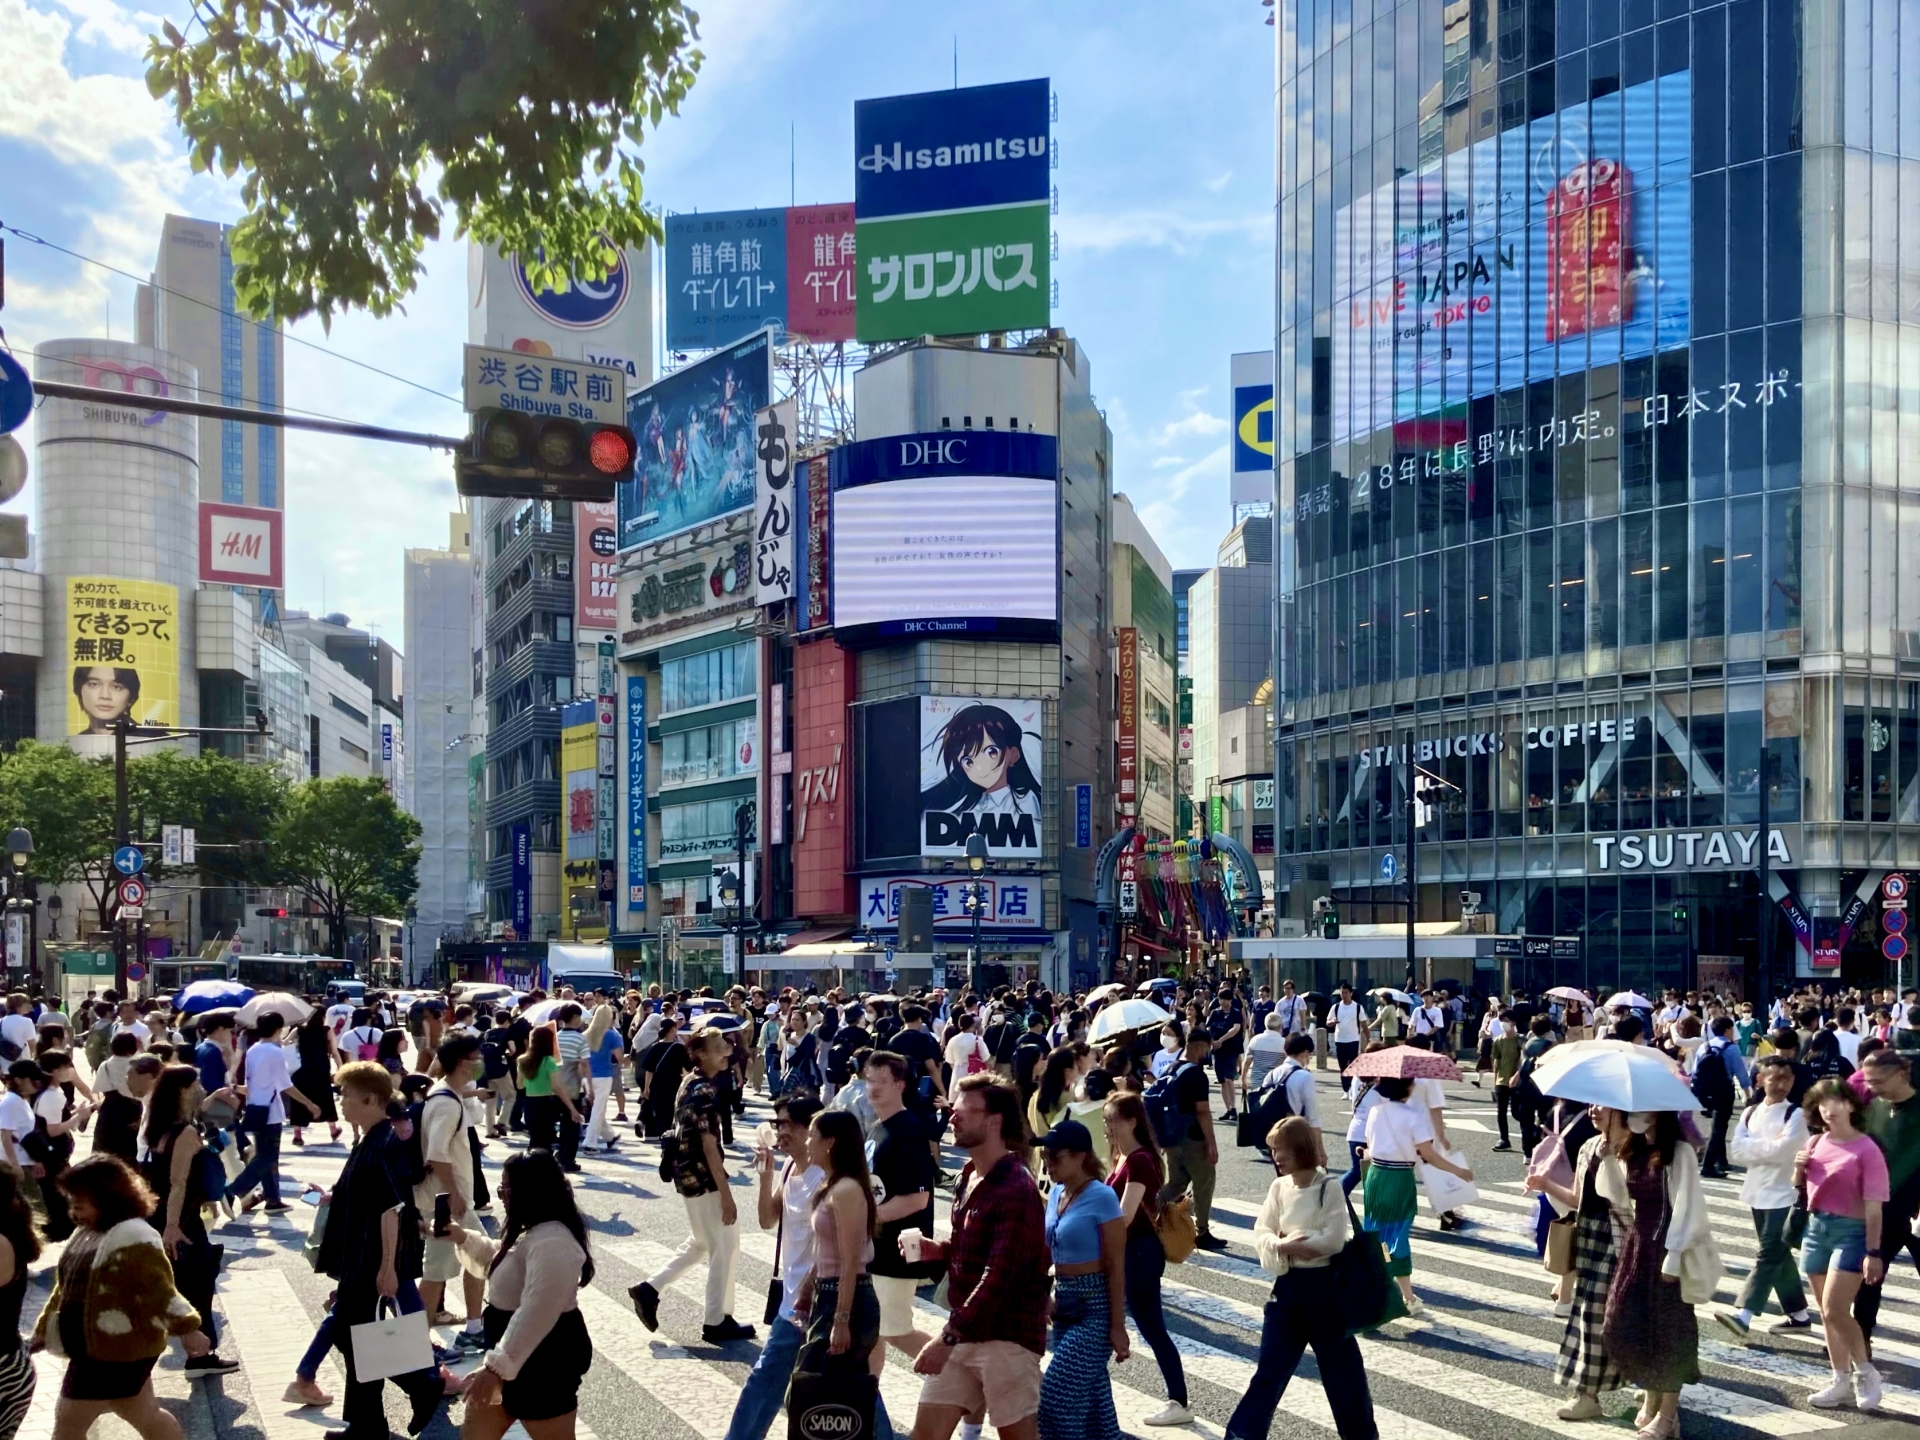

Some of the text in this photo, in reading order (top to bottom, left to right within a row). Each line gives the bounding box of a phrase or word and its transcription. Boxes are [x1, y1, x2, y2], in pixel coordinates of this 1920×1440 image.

[858, 136, 1046, 173] Hisamitsu
[691, 238, 762, 275] 龍角散
[868, 243, 1037, 303] サロンパス
[682, 275, 776, 312] ダイレクト
[478, 356, 613, 404] 渋谷駅前
[83, 406, 138, 425] SHIBUYA
[500, 392, 599, 421] Shibuya Sta.
[901, 439, 968, 466] DHC
[757, 409, 791, 595] もんじゃ
[220, 531, 262, 560] H&M
[73, 582, 121, 595] 光の力で、
[73, 597, 173, 616] 不可能を超えていく。
[73, 612, 171, 642] できるって、
[904, 620, 967, 632] DHC Channel
[73, 637, 136, 664] 無限。
[1521, 717, 1637, 750] COFFEE
[630, 703, 643, 824] サマーフルーツギフト
[1121, 735, 1135, 794] 三千里
[1592, 829, 1792, 870] TSUTAYA
[809, 1415, 853, 1432] SABON
